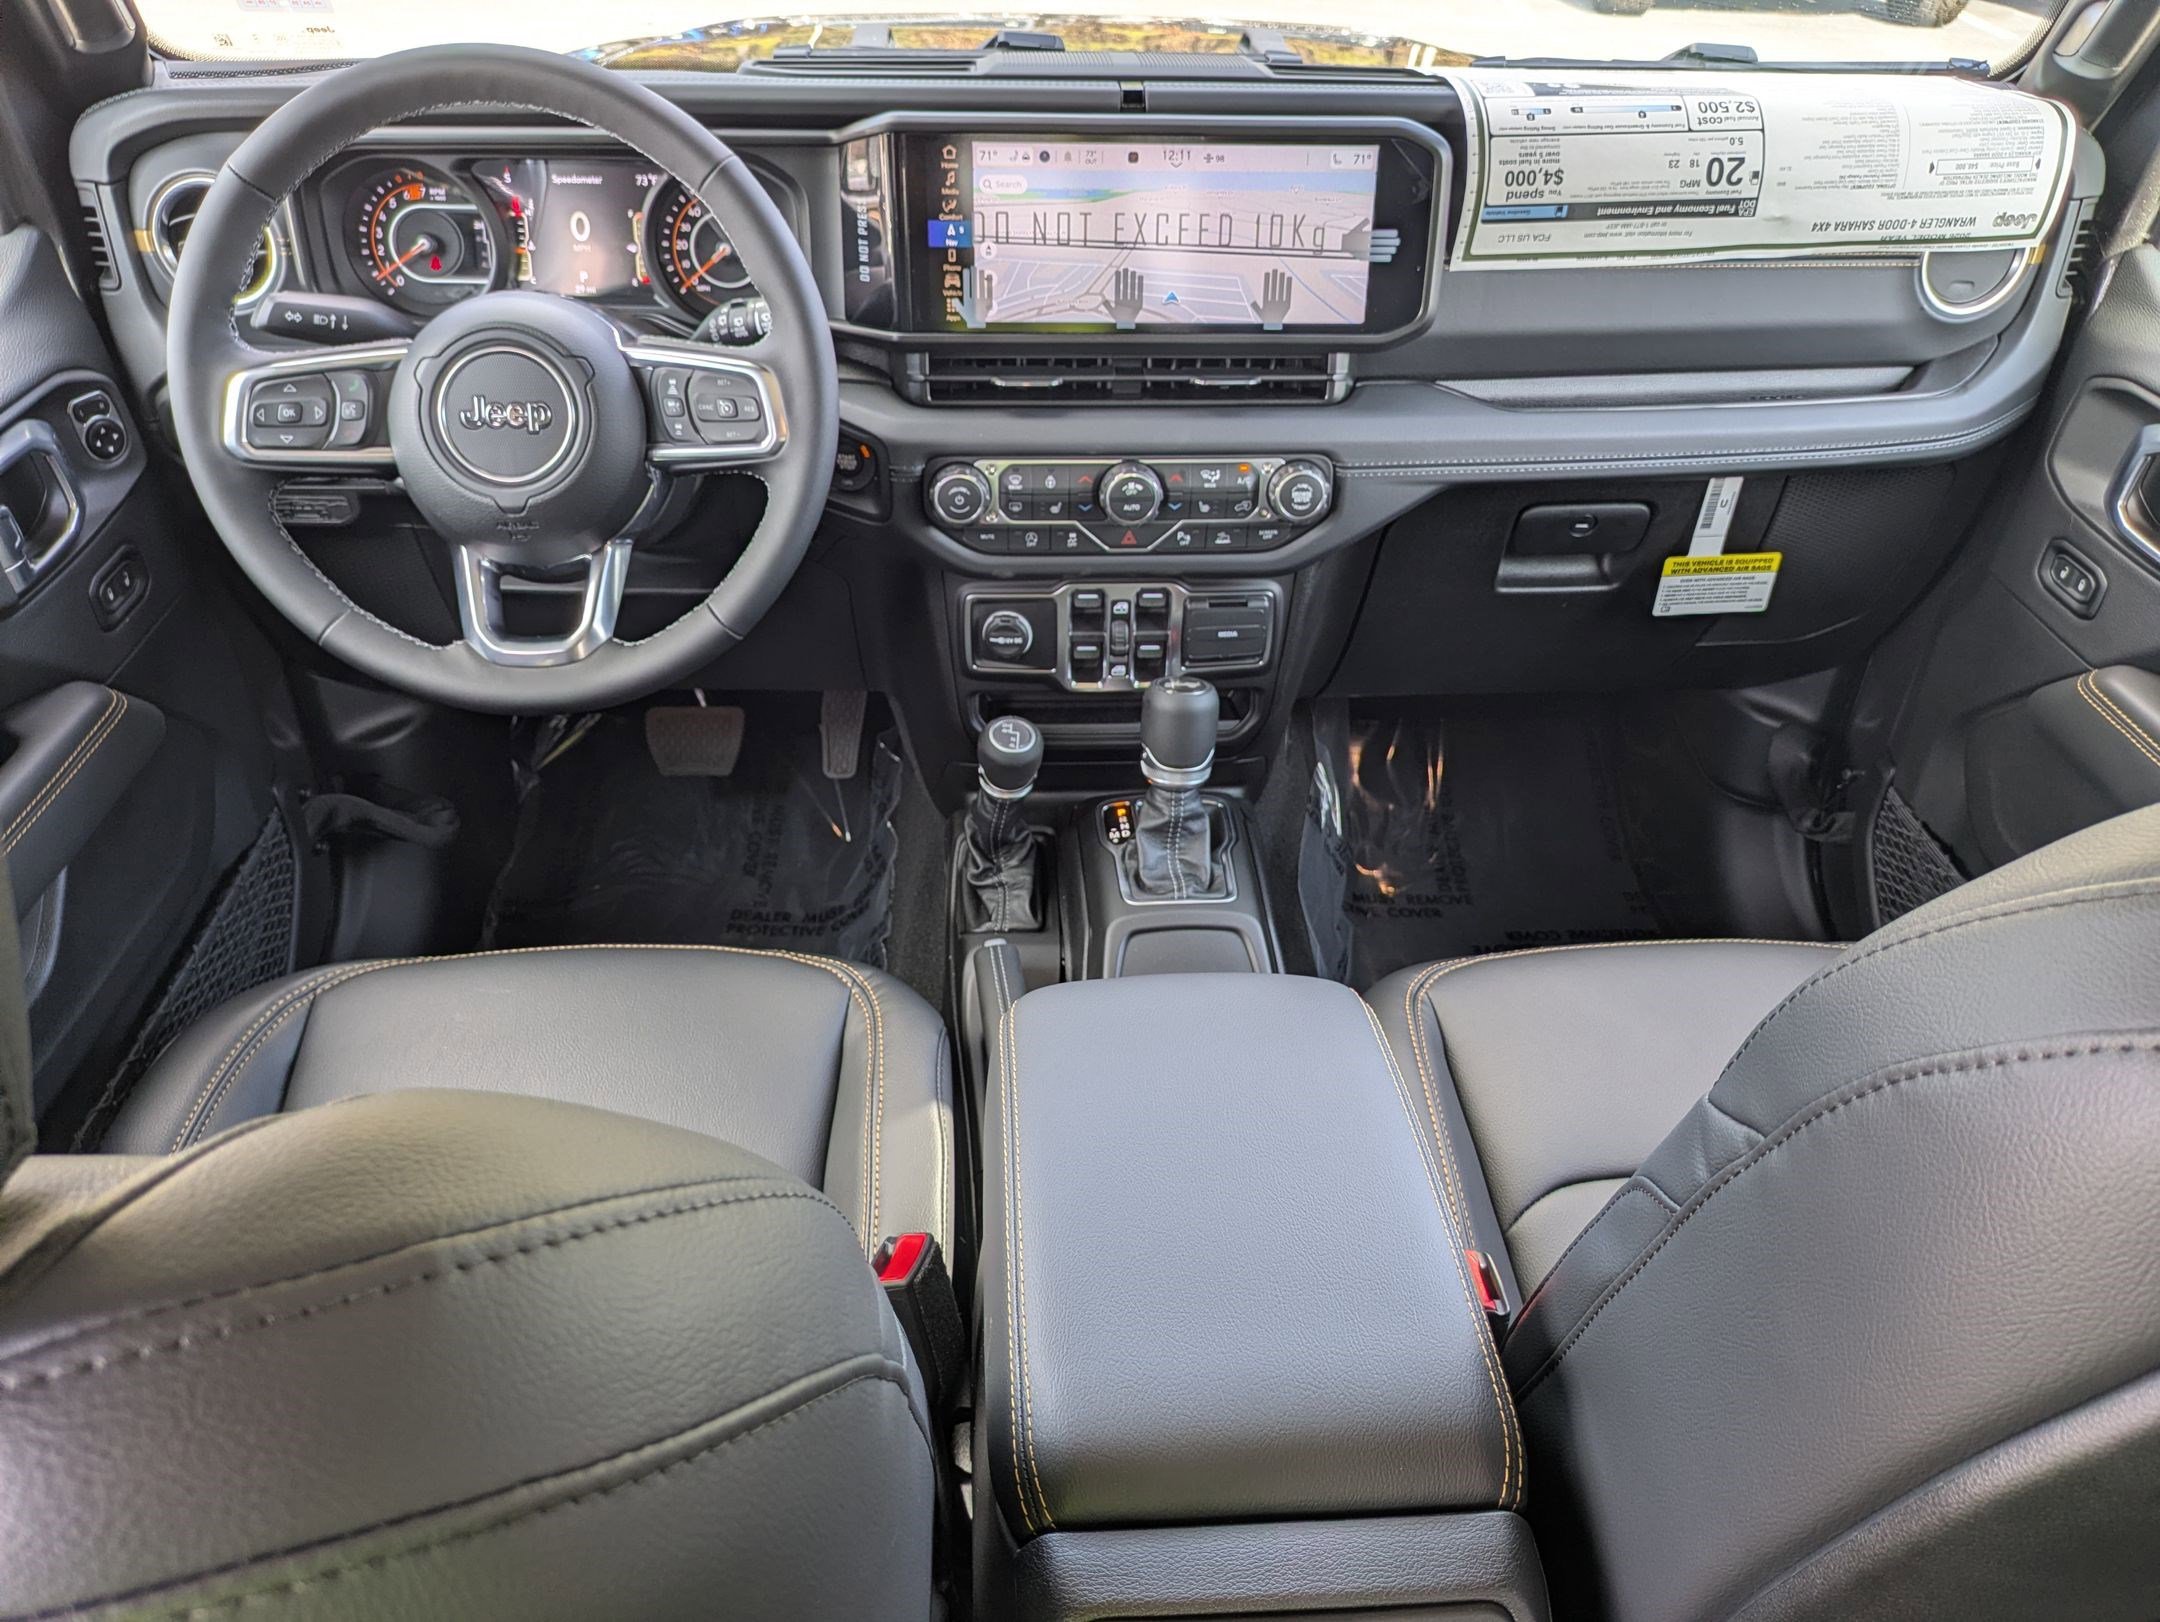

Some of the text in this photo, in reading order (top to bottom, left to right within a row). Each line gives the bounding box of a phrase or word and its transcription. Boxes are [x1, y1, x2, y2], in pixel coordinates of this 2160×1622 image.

[1698, 100, 1755, 113] $2,500
[1697, 116, 1723, 127] cost
[1729, 137, 1744, 145] 5.0
[980, 150, 998, 161] 71°
[1162, 150, 1191, 161] 12:11
[1353, 154, 1372, 165] 71°
[1668, 160, 1680, 168] 23
[1689, 159, 1700, 168] 18
[1505, 167, 1564, 187] $4,000
[1705, 157, 1745, 187] 20
[551, 173, 603, 186] Speedometer
[995, 180, 1022, 189] Search
[1680, 179, 1701, 188] MPG
[403, 190, 411, 200] 6
[419, 187, 426, 199] 7
[429, 188, 446, 196] RPM
[1505, 188, 1544, 201] spend
[388, 198, 398, 209] 5
[1739, 200, 1756, 208] DOT
[1597, 203, 1735, 216] Fuel Economy and Environment
[1739, 208, 1754, 216] EPA
[379, 211, 387, 222] 4
[1992, 212, 2037, 230] Jeep
[570, 211, 591, 242] 0
[1811, 217, 1976, 232] WRANGLER 4-DOOR SAHARA 4X4
[375, 227, 383, 239] 3
[972, 211, 1325, 255] DO NOT EXCEED 10Kg
[1498, 233, 1551, 243] FCA US LLC
[377, 244, 385, 256] 2
[676, 239, 689, 251] 20
[858, 239, 869, 263] NOT
[859, 265, 870, 282] DO
[395, 275, 405, 287] 0
[282, 409, 297, 418] OK
[459, 394, 552, 437] Jeep
[1236, 476, 1250, 486] A/C
[1125, 489, 1138, 497] OFF
[1026, 540, 1038, 548] OFF
[1117, 808, 1126, 816] P
[1120, 822, 1130, 830] N
[1121, 830, 1131, 838] D
[1404, 893, 1473, 905] REMOVE
[730, 908, 792, 922] DEALER
[1386, 906, 1443, 917] COVER
[725, 922, 826, 937] PROTECTIVE
